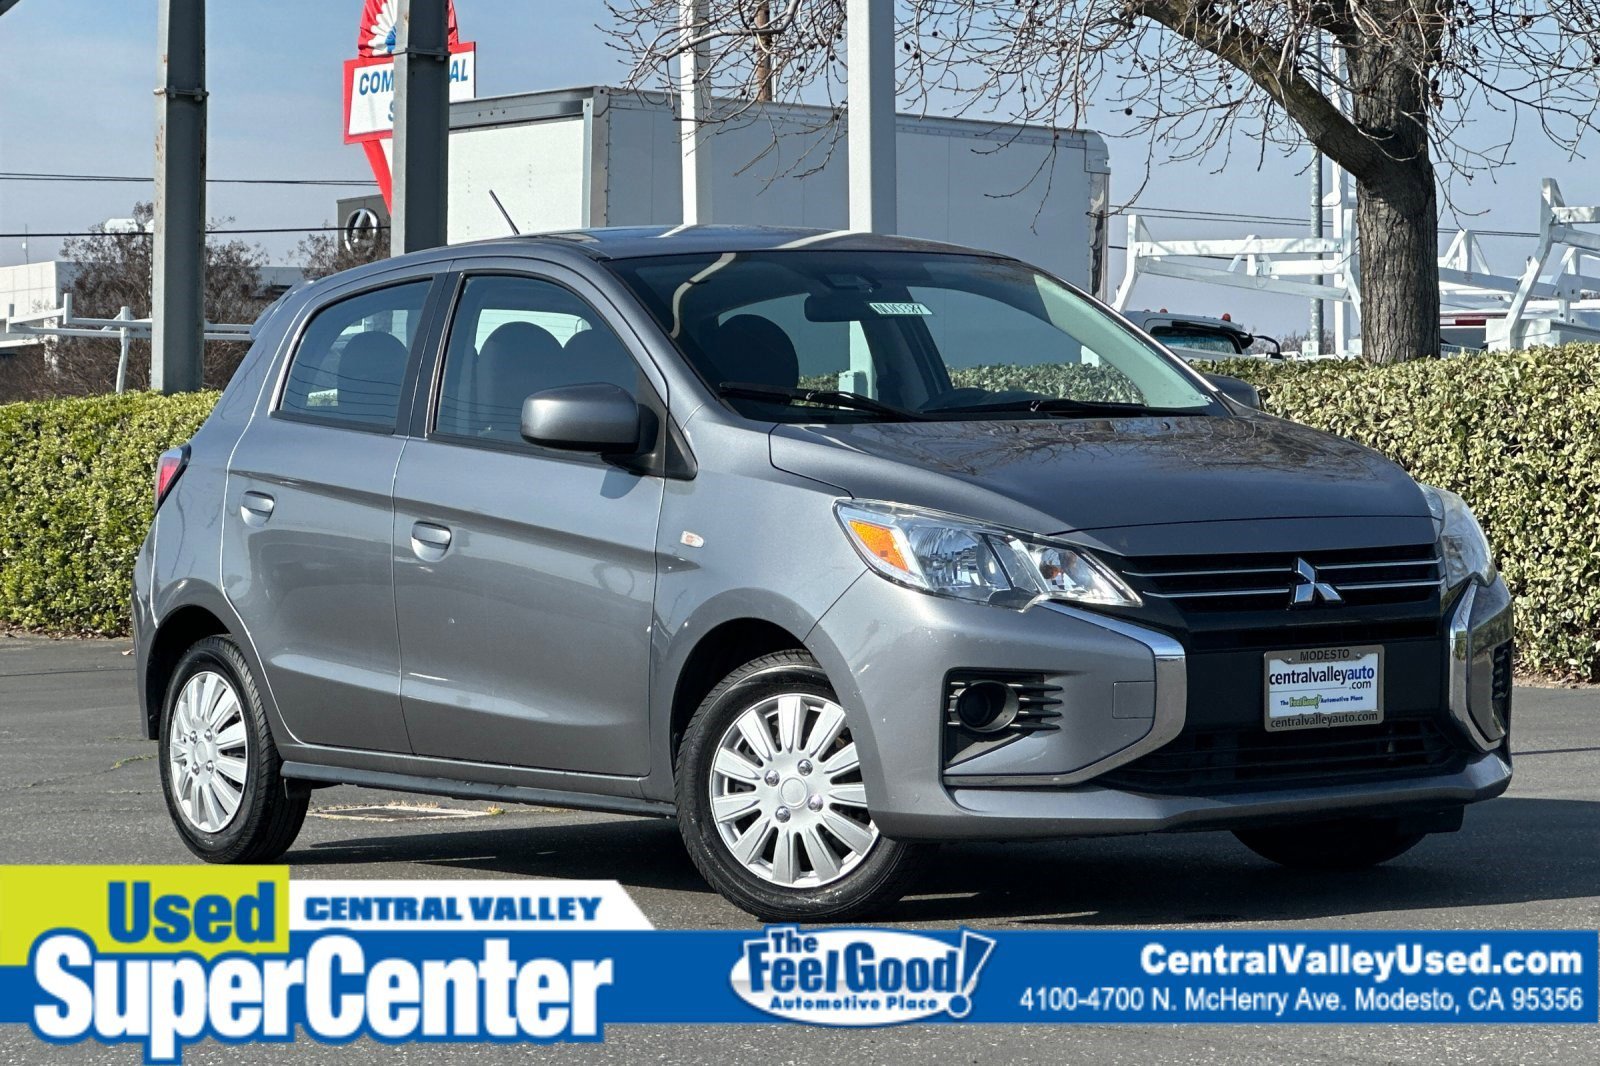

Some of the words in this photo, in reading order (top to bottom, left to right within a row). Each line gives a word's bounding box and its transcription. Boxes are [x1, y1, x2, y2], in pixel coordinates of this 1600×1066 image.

[1300, 649, 1350, 661] MODESTO
[1269, 666, 1374, 685] centralvalleyauto
[1349, 681, 1372, 690] .com
[1270, 713, 1378, 728] centralvalleyauto.com
